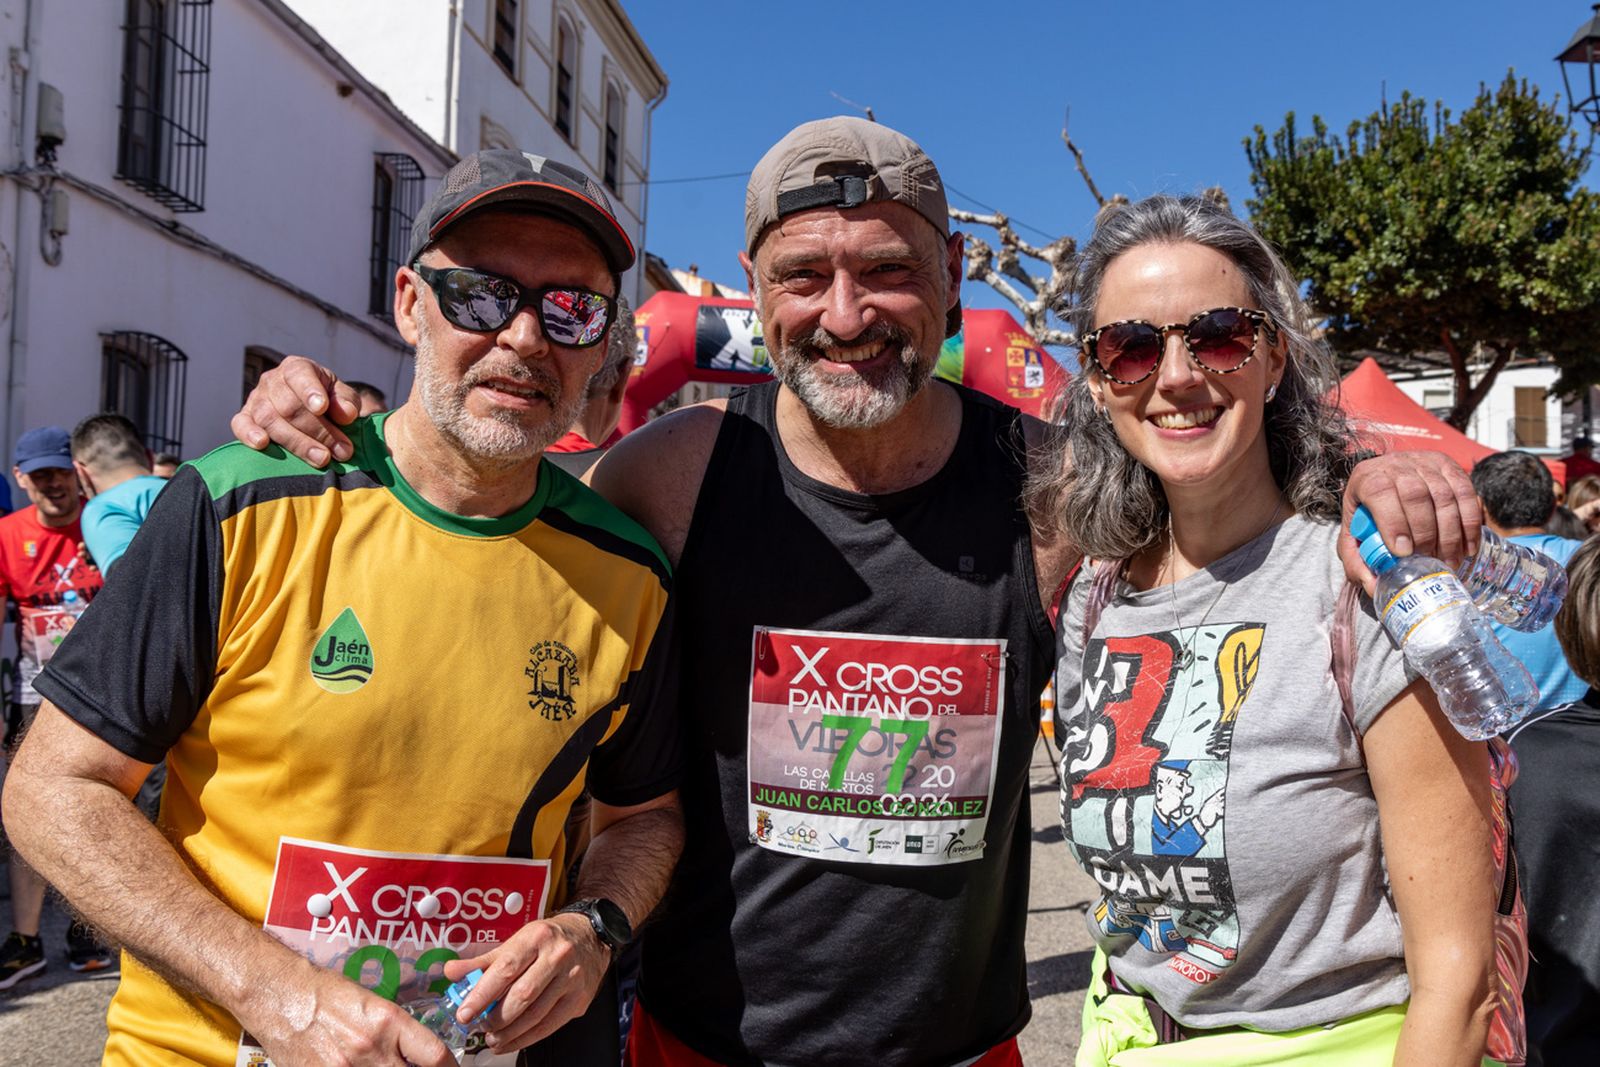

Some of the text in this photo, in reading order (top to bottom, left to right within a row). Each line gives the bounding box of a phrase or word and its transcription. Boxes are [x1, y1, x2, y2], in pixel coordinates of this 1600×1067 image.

[314, 636, 370, 667] Jaén
[334, 654, 368, 665] clima
[789, 645, 963, 696] X CROSS
[788, 689, 961, 722] PANTANO DEL
[822, 714, 929, 794] 77
[784, 765, 875, 782] LAS CALLAS
[800, 778, 874, 794] DE MRTOS
[920, 764, 955, 788] 20
[755, 788, 984, 816] JUAN CARLOS GONZALEZ
[323, 861, 503, 921] X CROSS
[1090, 856, 1217, 903] GAME
[309, 915, 500, 951] PANTANO DEL
